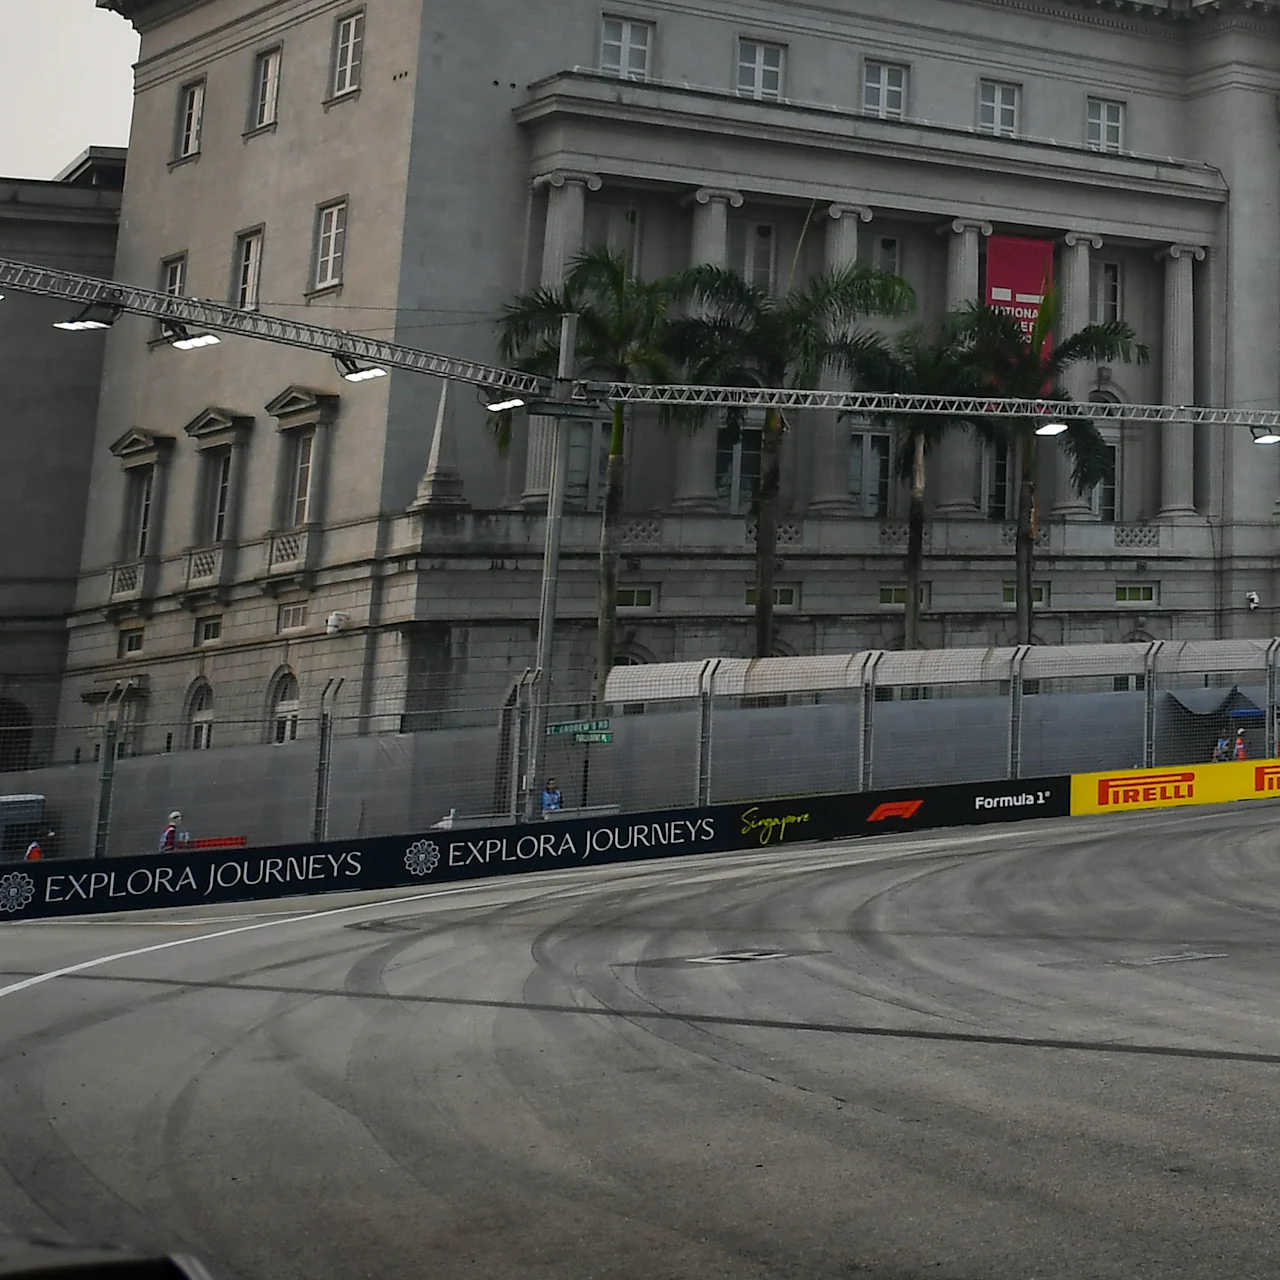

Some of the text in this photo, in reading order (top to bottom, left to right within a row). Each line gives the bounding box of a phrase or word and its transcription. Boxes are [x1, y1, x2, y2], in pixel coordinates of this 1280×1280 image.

[975, 793, 1034, 810] Formula
[1098, 772, 1195, 806] PIRELLI
[448, 818, 715, 866] EXPLORA JOURNEYS
[740, 807, 811, 845] Singapore
[45, 851, 362, 902] EXPLORA JOURNEYS
